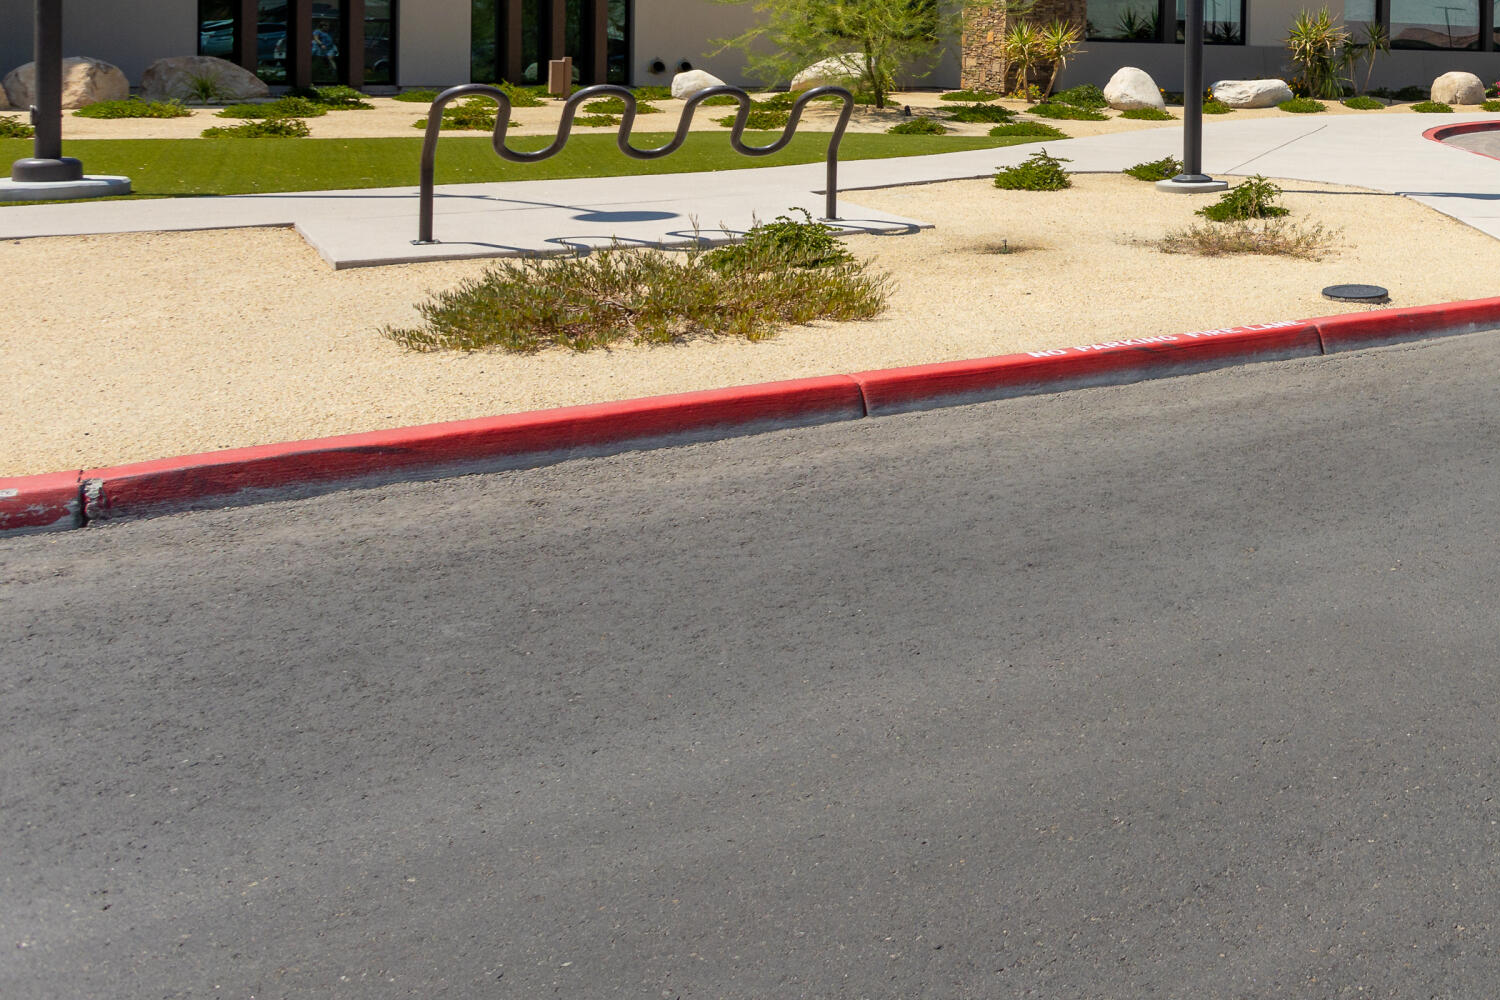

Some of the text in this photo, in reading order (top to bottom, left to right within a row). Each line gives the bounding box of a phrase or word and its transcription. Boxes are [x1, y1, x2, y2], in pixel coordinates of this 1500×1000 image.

[1027, 319, 1307, 358] NO PARKING FIRE LANE
